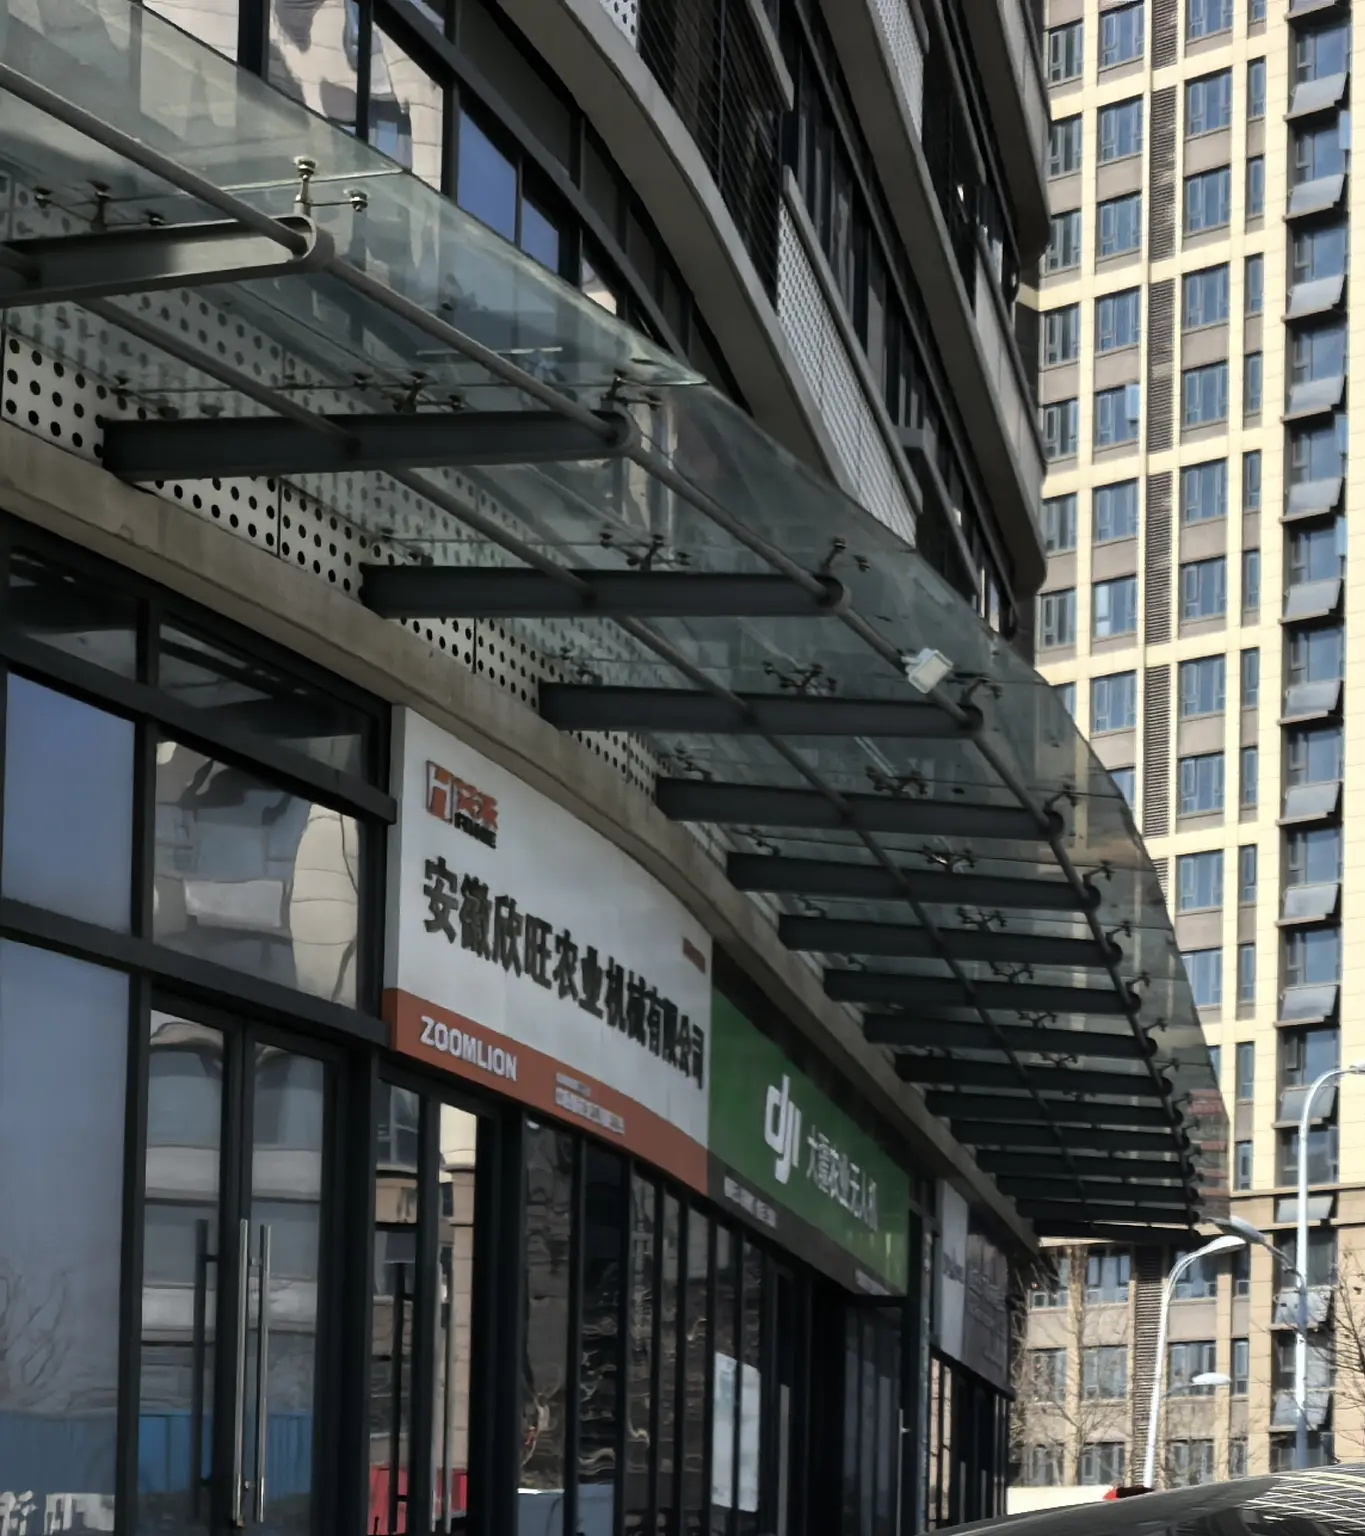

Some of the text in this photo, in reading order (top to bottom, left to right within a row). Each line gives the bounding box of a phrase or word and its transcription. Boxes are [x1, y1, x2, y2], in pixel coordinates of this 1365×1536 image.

[424, 856, 704, 1089] 安徽欣旺农业机械有限公司
[420, 1015, 517, 1082] ZOOMLION
